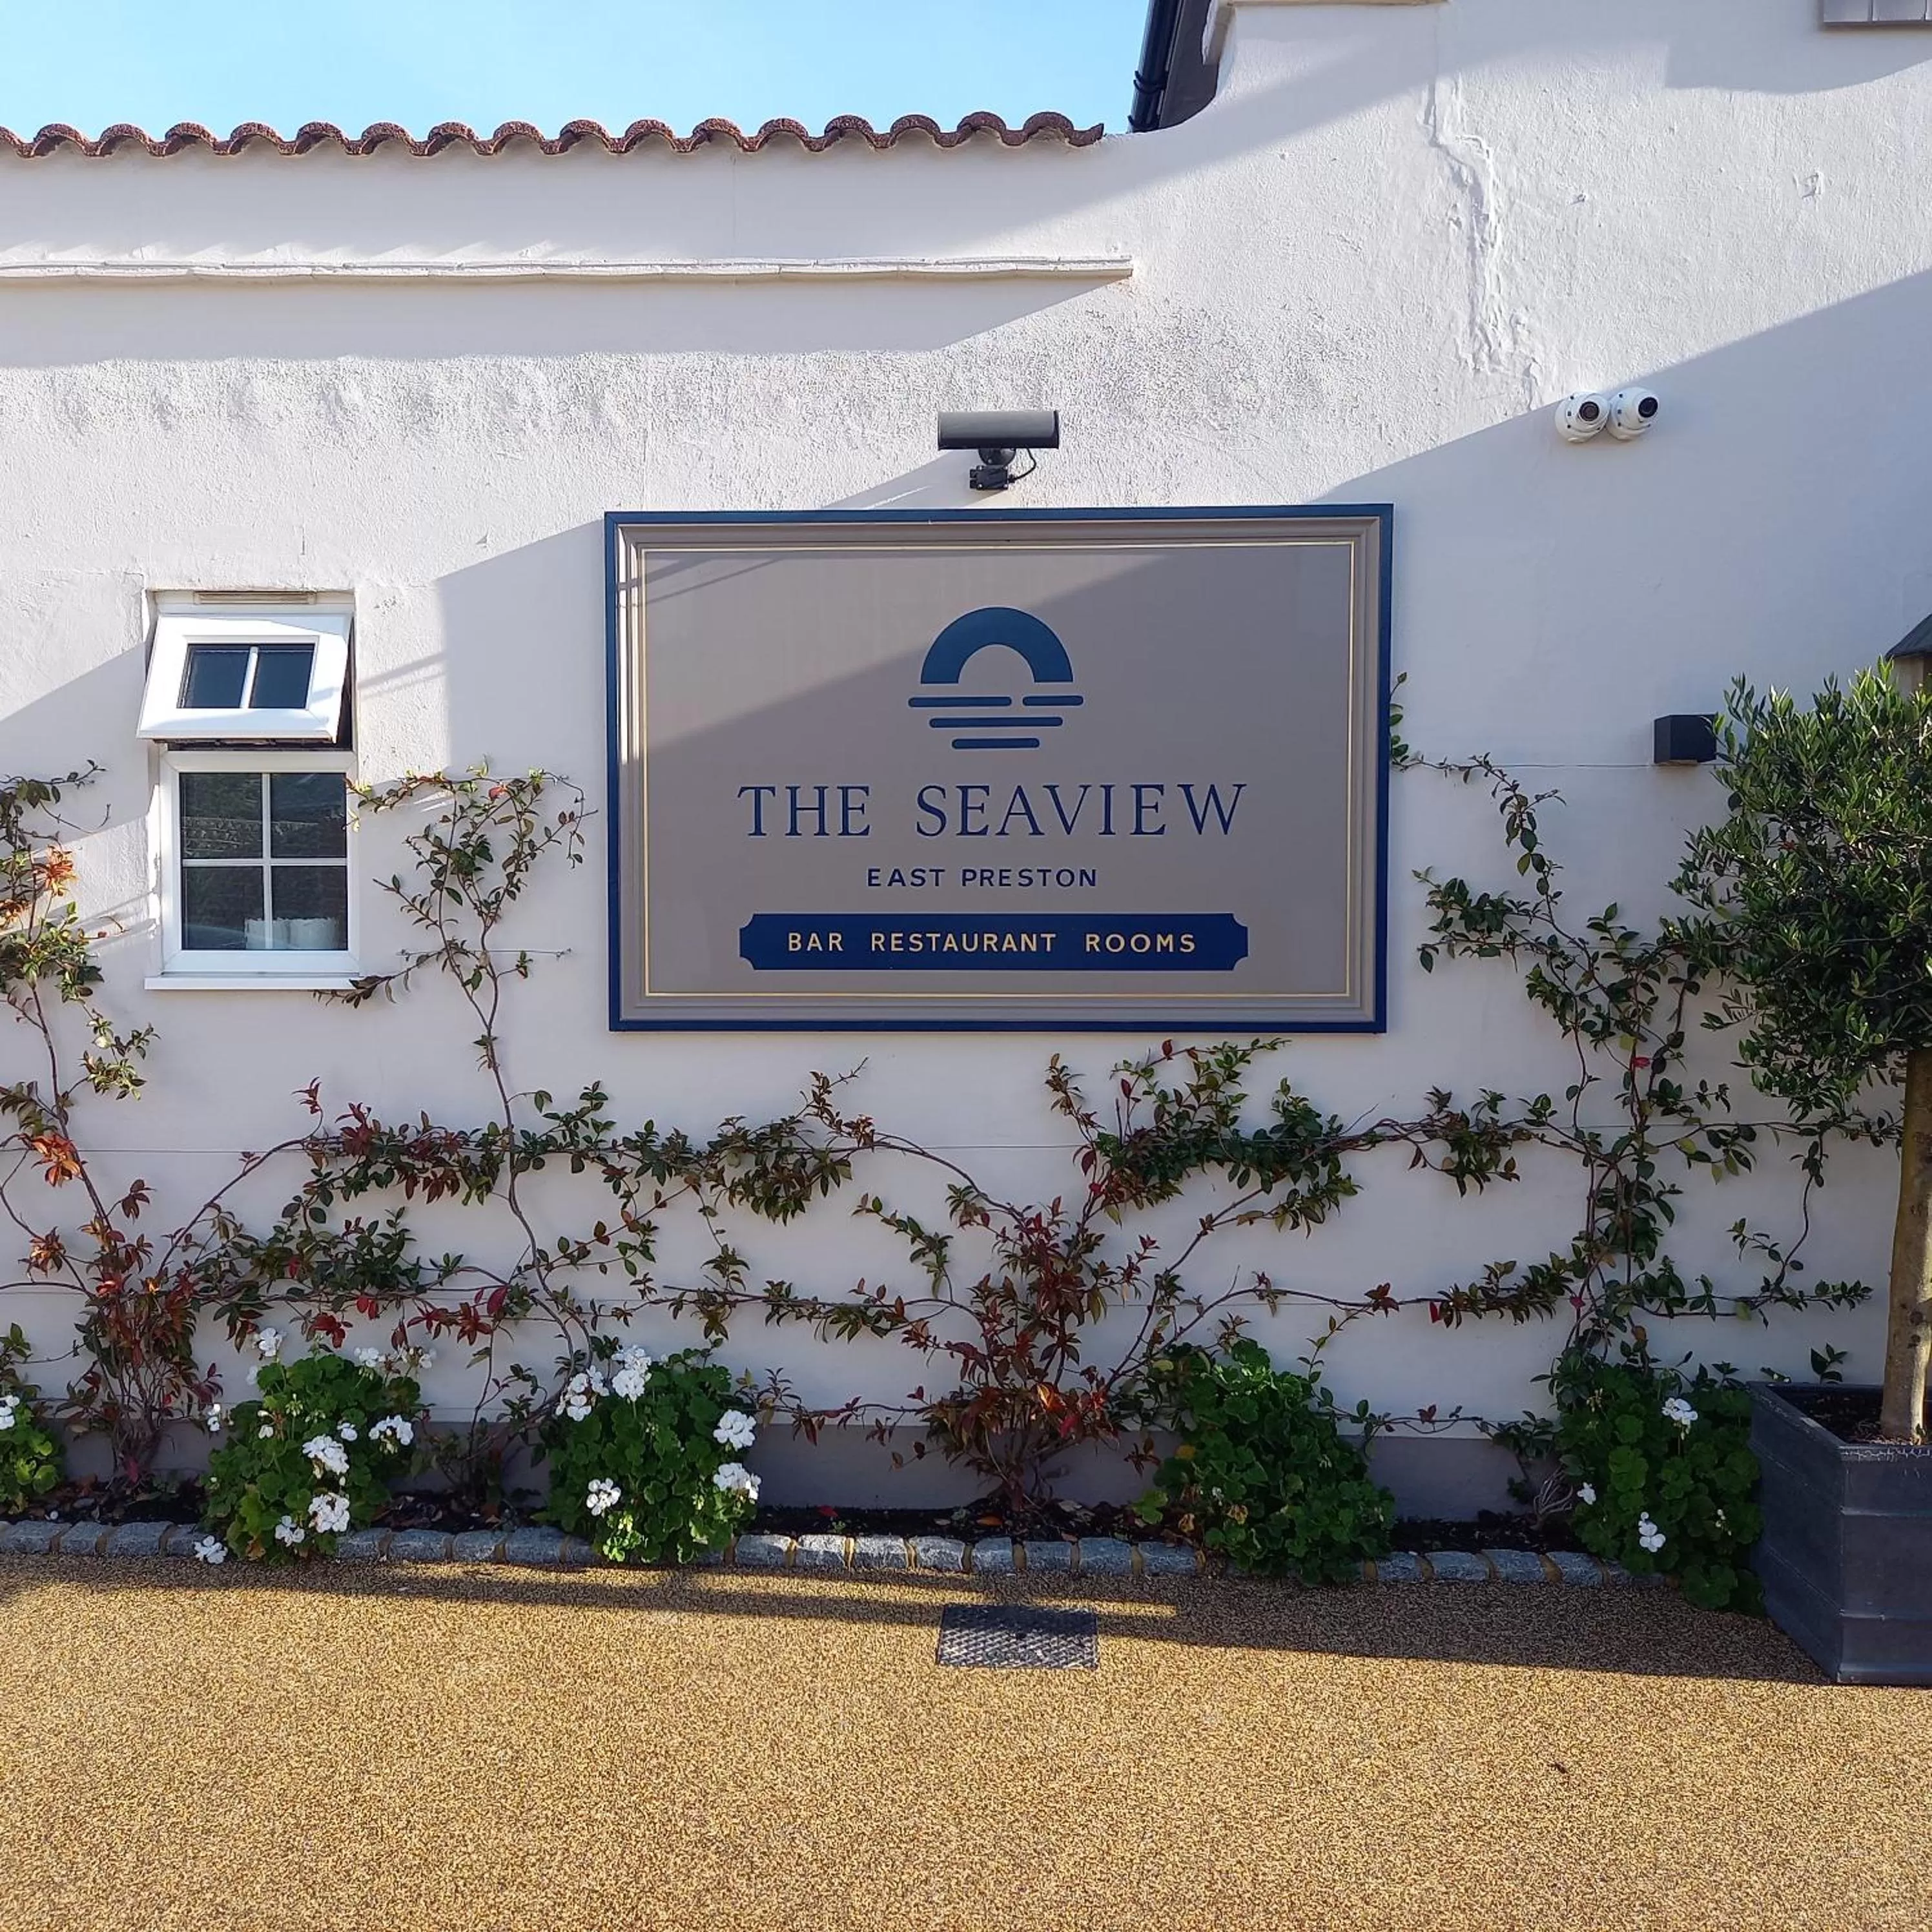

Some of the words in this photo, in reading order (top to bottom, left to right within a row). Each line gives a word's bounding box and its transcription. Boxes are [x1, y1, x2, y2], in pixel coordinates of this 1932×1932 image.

[737, 785, 871, 838] THE
[915, 783, 1248, 838] SEAVIEW
[867, 868, 945, 887] EAST
[961, 868, 1098, 887] PRESTON
[788, 932, 844, 952] BAR
[870, 932, 1057, 952] RESTAURANT
[1084, 932, 1197, 952] ROOMS
